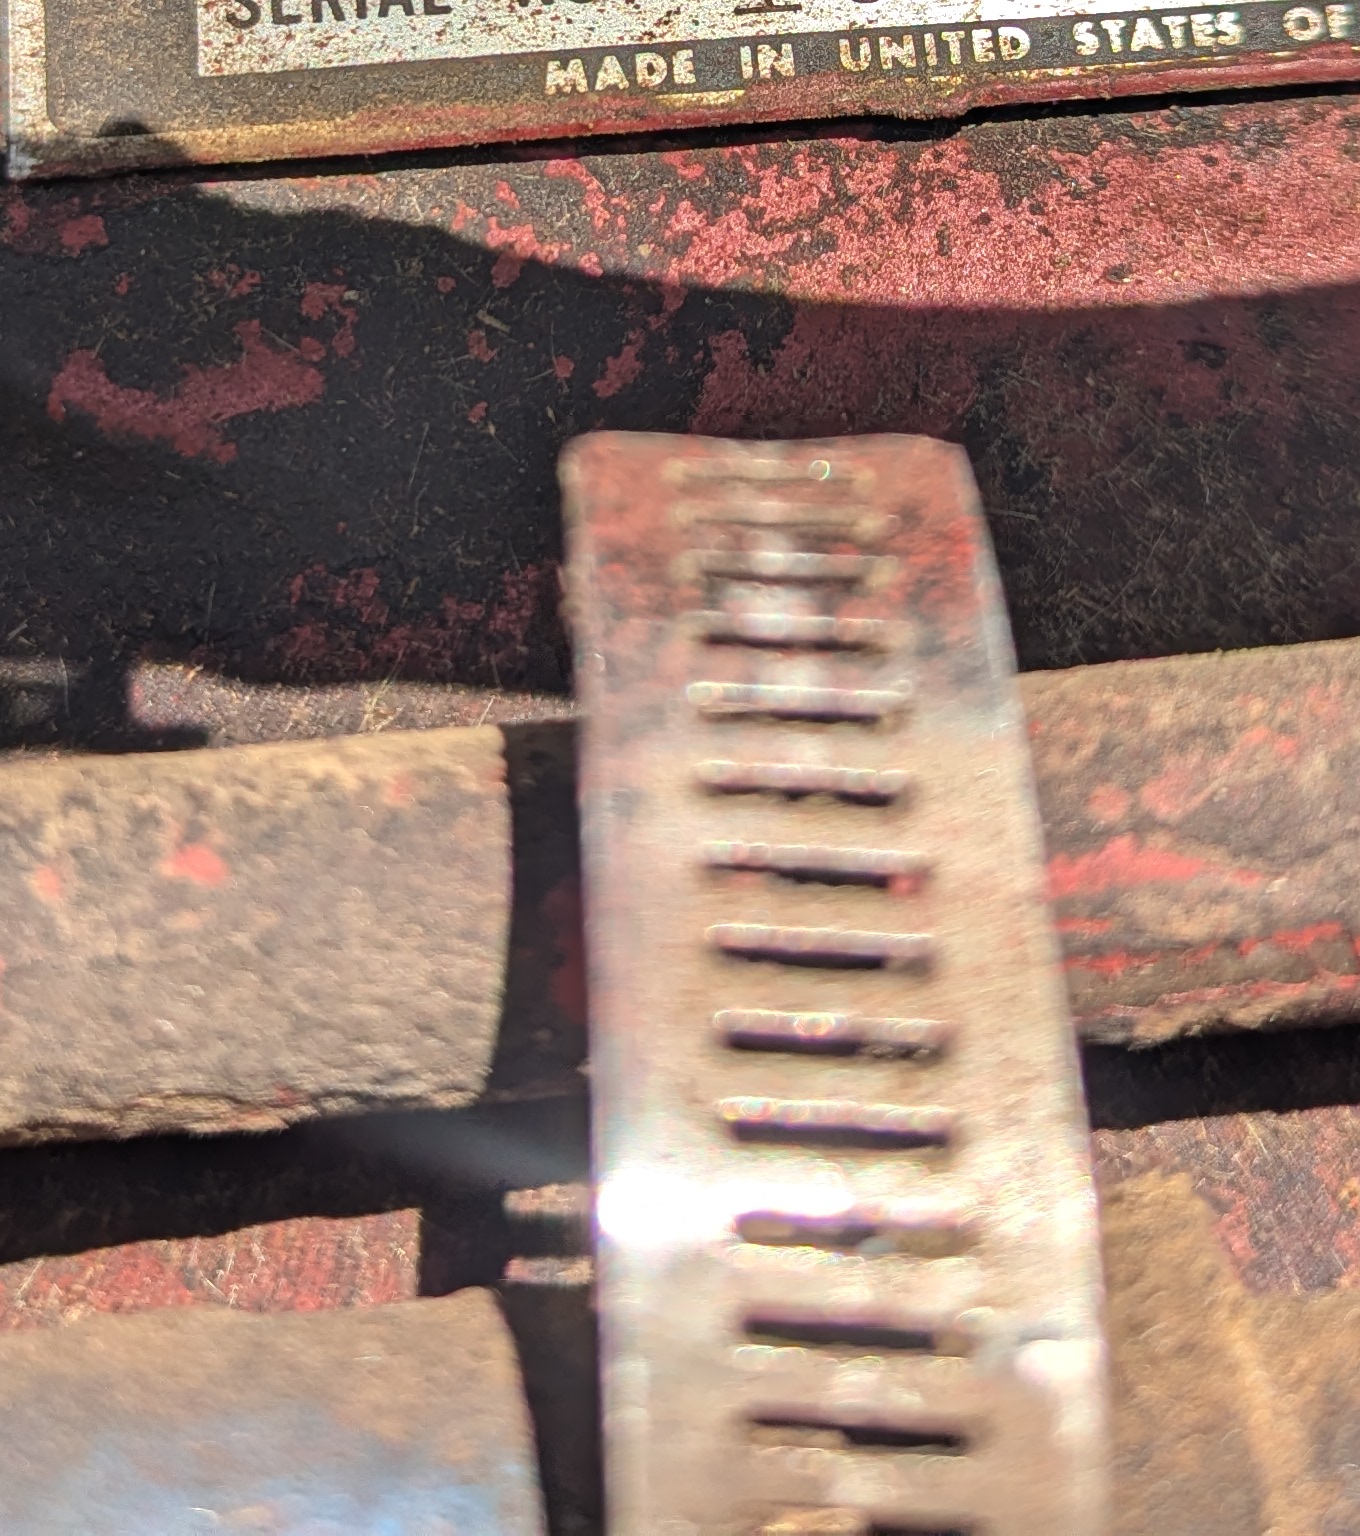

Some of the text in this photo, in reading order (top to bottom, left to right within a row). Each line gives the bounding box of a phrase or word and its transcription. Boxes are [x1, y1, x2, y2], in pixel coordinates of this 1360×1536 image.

[543, 48, 698, 96] MADE
[737, 42, 796, 81] IN
[837, 24, 1031, 73] UNITED
[1072, 9, 1245, 57] STATES
[1280, 2, 1356, 43] OF
